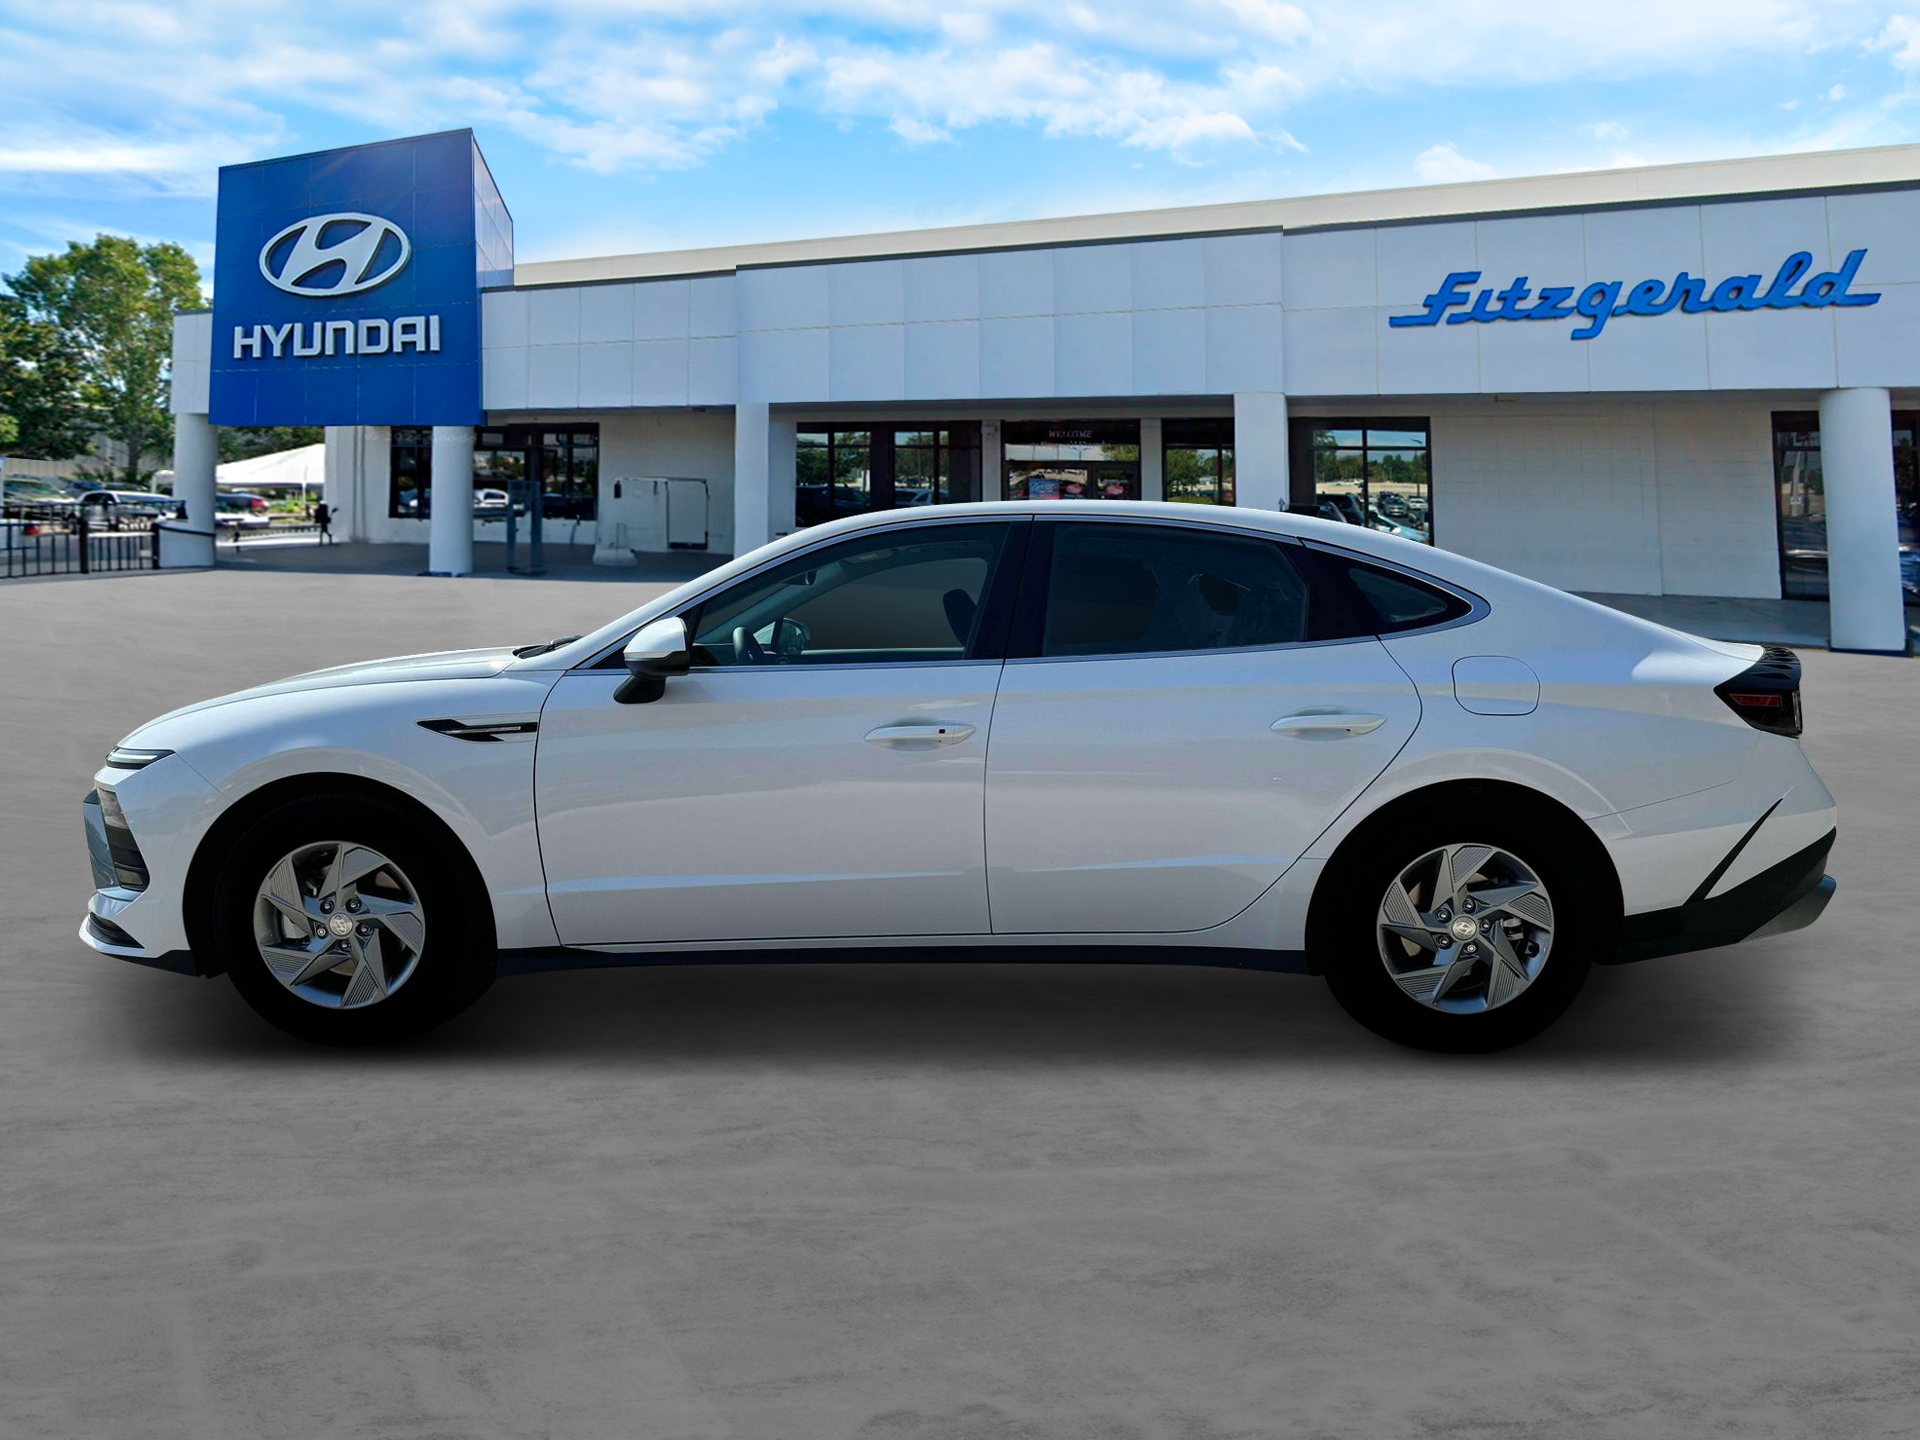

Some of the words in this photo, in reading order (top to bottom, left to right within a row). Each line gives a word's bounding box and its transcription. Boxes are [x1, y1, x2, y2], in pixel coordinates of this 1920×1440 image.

[1389, 248, 1881, 340] Fitzgerald
[233, 315, 441, 359] HYUNDAI
[1048, 430, 1092, 438] WELCOME
